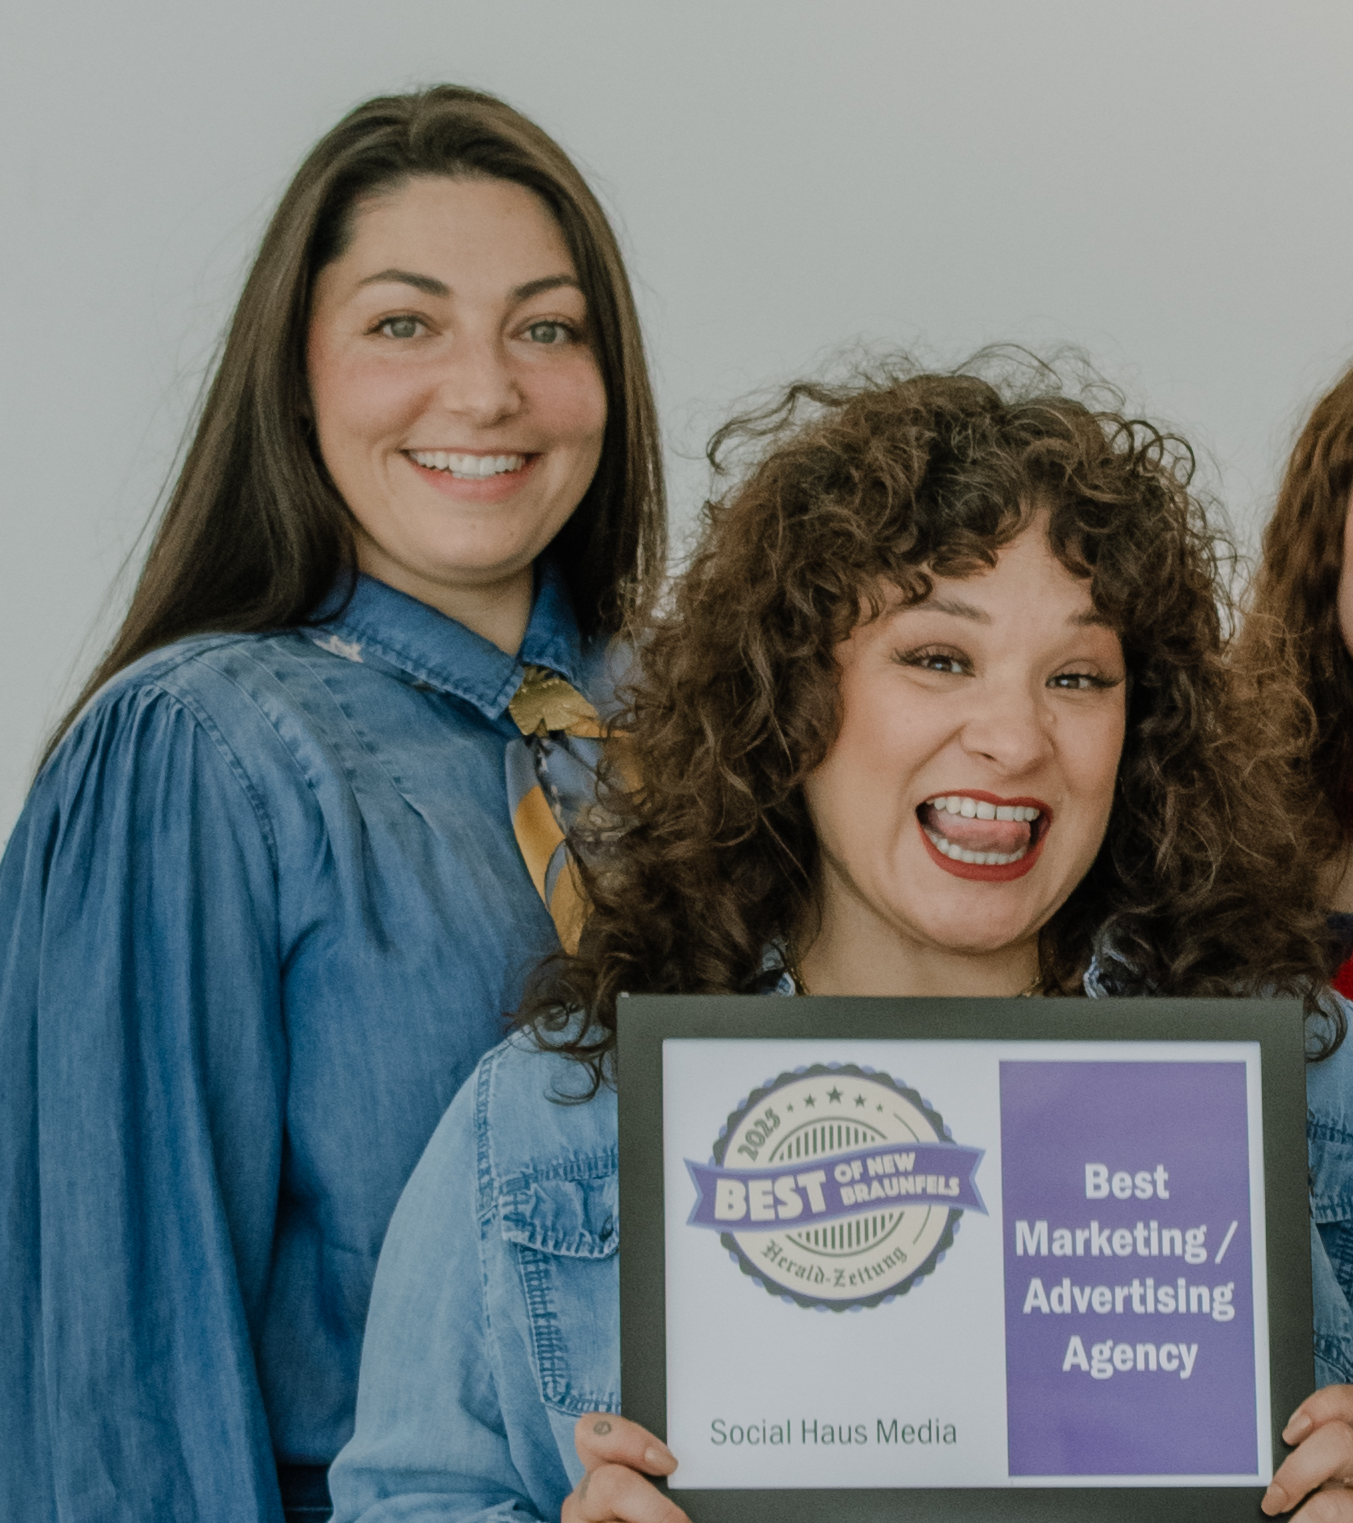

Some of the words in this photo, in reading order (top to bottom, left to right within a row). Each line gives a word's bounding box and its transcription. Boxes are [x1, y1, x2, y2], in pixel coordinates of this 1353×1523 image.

[736, 1106, 782, 1163] 2025
[834, 1159, 865, 1185] OF
[866, 1151, 917, 1178] NEW
[838, 1173, 961, 1207] BRAUNFELS
[1084, 1162, 1171, 1201] Best
[713, 1168, 828, 1223] BEST
[760, 1238, 909, 1289] Herald-Zeitung
[1022, 1276, 1236, 1323] Advertising
[1061, 1334, 1199, 1380] Agency
[709, 1417, 792, 1447] Social
[801, 1417, 869, 1447] Haus
[876, 1417, 958, 1447] Media
